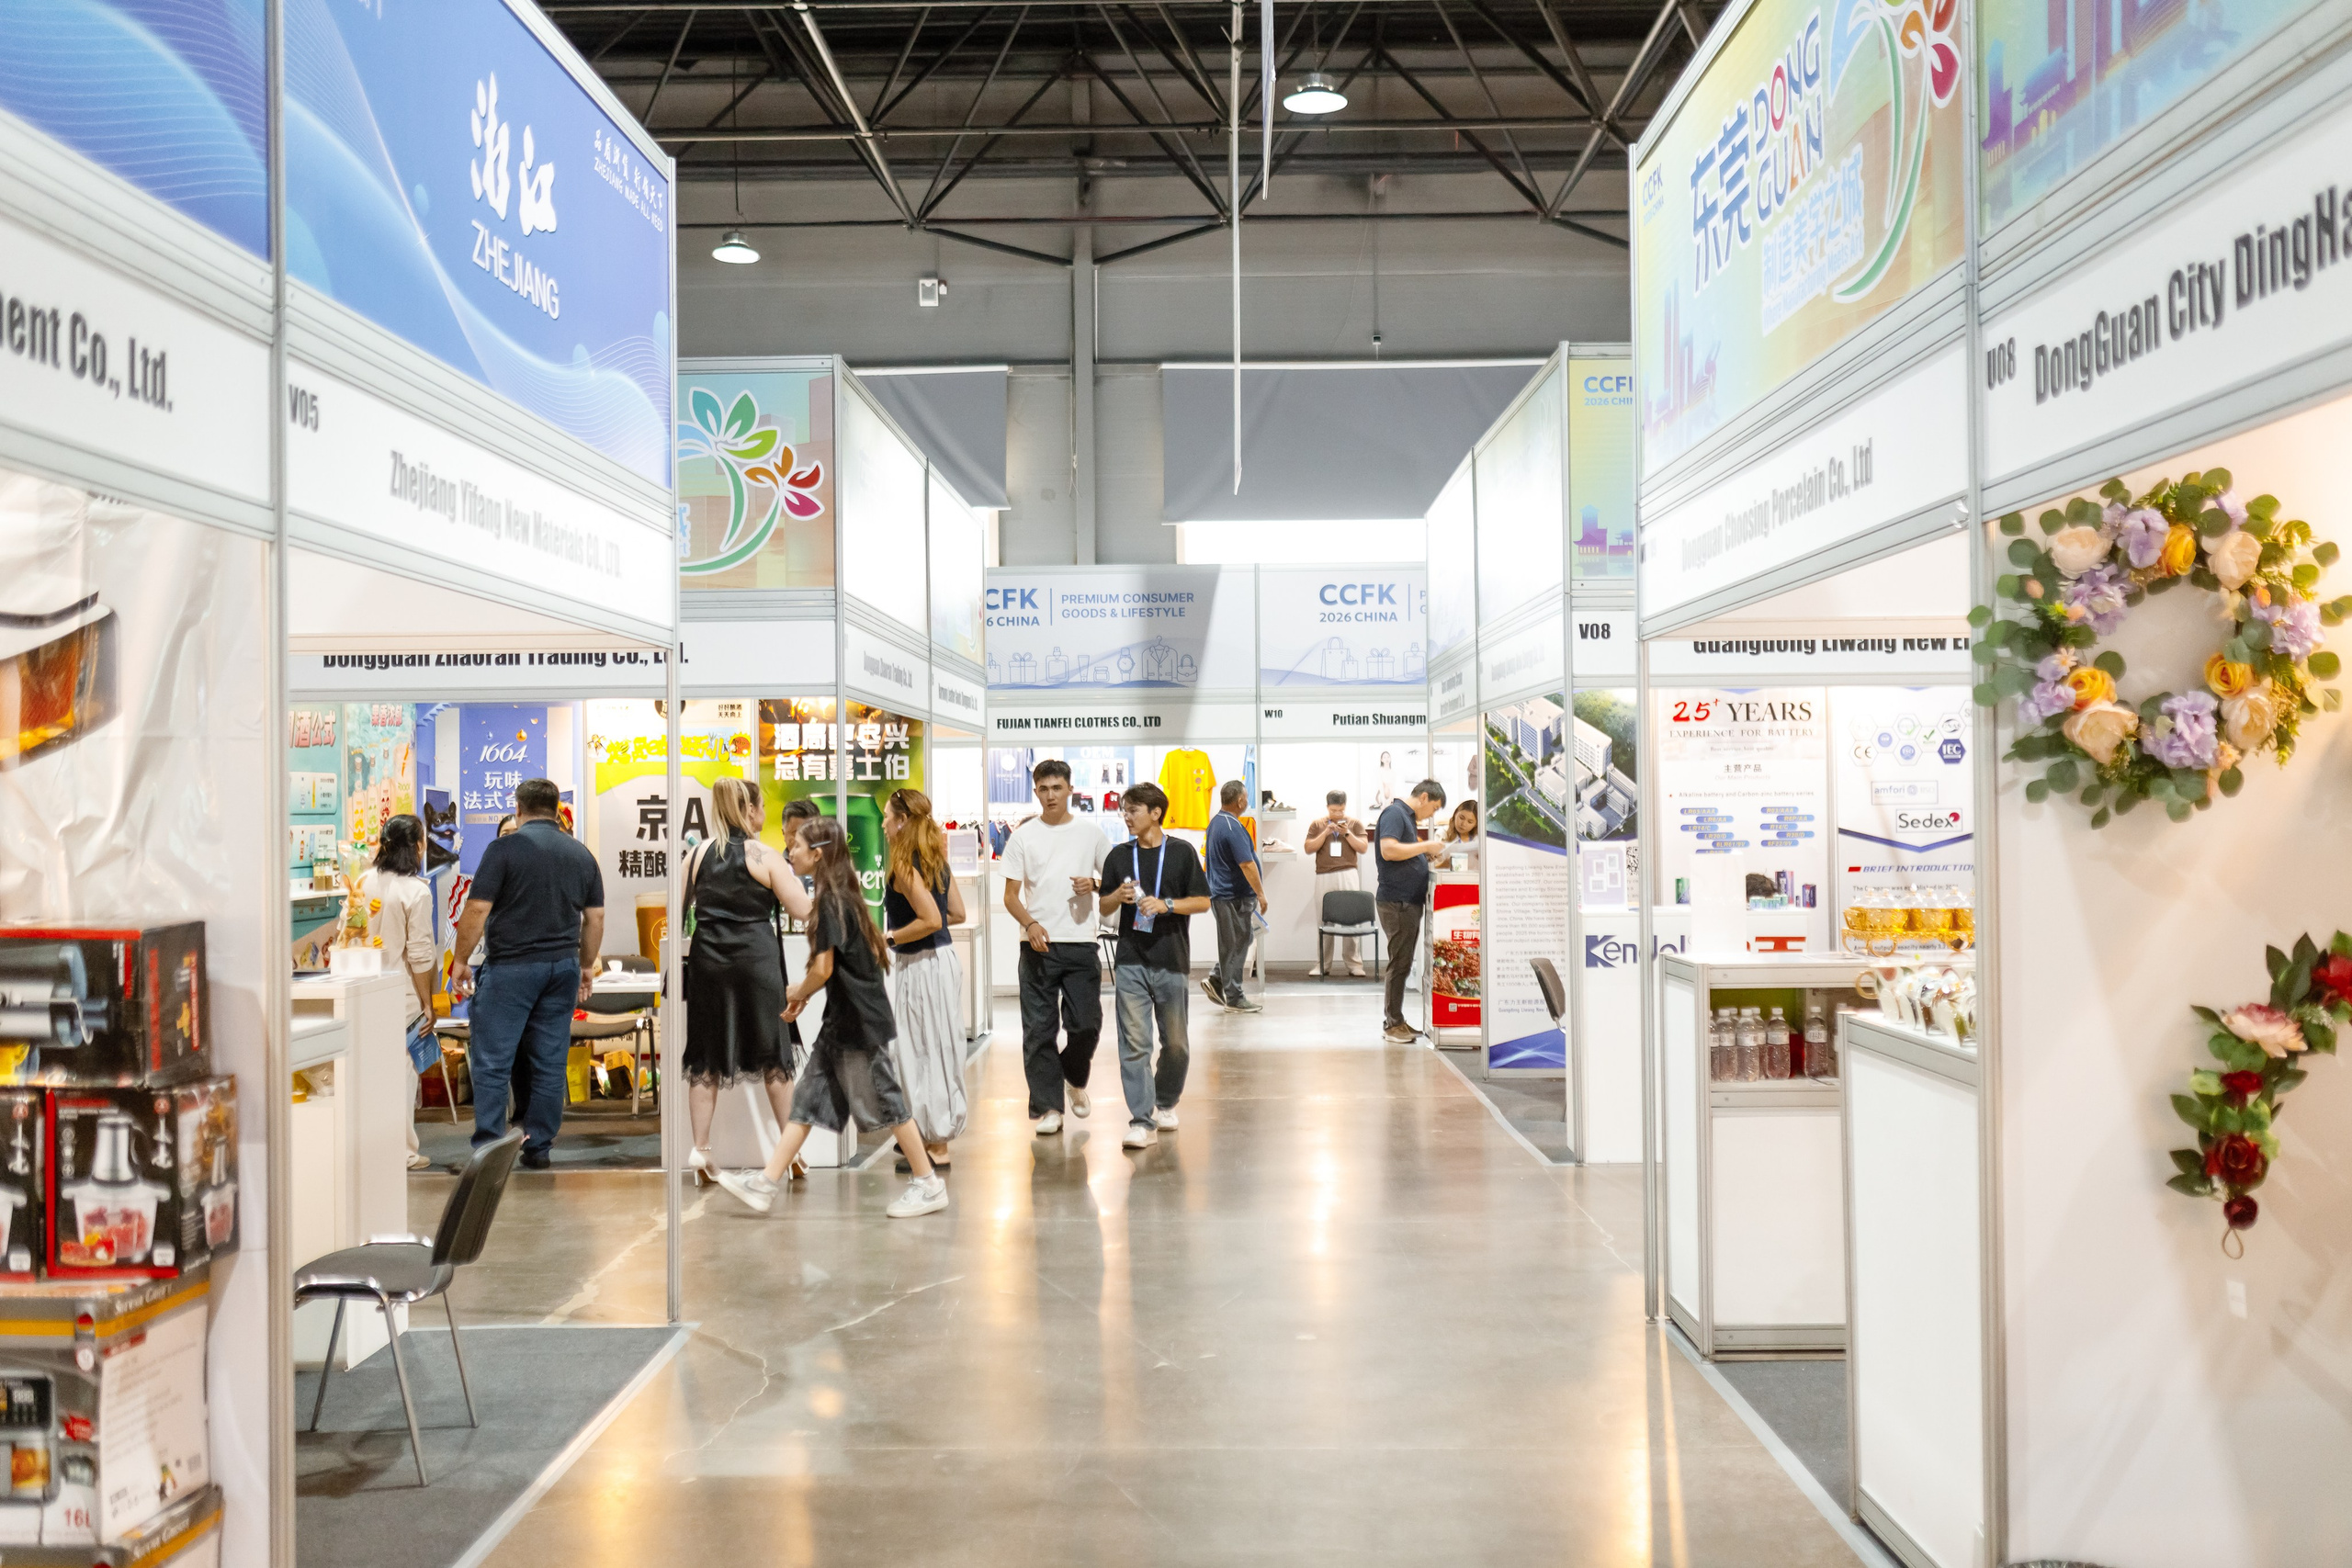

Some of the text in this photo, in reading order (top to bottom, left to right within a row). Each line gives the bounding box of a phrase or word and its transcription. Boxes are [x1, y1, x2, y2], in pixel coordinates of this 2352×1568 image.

[1755, 14, 1821, 153] DONG
[470, 72, 558, 237] 浙江
[1757, 95, 1825, 221] GUAN
[1643, 163, 1663, 207] CCFK
[1690, 106, 1751, 293] 东莞
[1763, 152, 1863, 296] 制造美学之城
[470, 220, 560, 320] ZHEJIANG
[2035, 294, 2161, 406] DongGuan
[2168, 257, 2227, 342] City
[70, 310, 121, 400] Co.,
[129, 337, 173, 413] Ltd.
[1987, 336, 2017, 390] U08
[288, 384, 319, 433] V05
[1584, 397, 1610, 406] 2026
[390, 449, 457, 525] Zhejiang
[460, 479, 502, 540] Yifang
[504, 499, 530, 546] New
[533, 510, 584, 565] Materials
[1681, 438, 1873, 572] Dongguan Choosing Porcelain Co., Ltd
[1061, 592, 1194, 604] PREMIUM CONSUMER
[1319, 583, 1396, 605] CCFK
[997, 616, 1041, 626] CHINA
[1061, 606, 1186, 618] GOODS & LIFESTYLE
[1319, 612, 1398, 623] 2026 CHINA
[1578, 623, 1611, 639] V08
[1264, 709, 1283, 719] W10
[1332, 713, 1369, 726] Putian
[1725, 702, 1813, 722] YEARS
[997, 716, 1162, 730] FUJIAN TIANFEI CLOTHES CO., LTD
[1669, 728, 1815, 739] EXPERIENCE FOR BATTERY
[479, 742, 528, 763] 1664
[1080, 747, 1114, 759] OEM
[1854, 745, 1872, 760] CE
[1942, 744, 1962, 755] IEC
[774, 754, 910, 781] 总有嘉士伯
[1723, 763, 1763, 773] 主营产品
[483, 771, 524, 790] 玩味
[1874, 784, 1905, 795] amfori
[636, 795, 709, 841] 京A
[1898, 812, 1954, 829] Sedex
